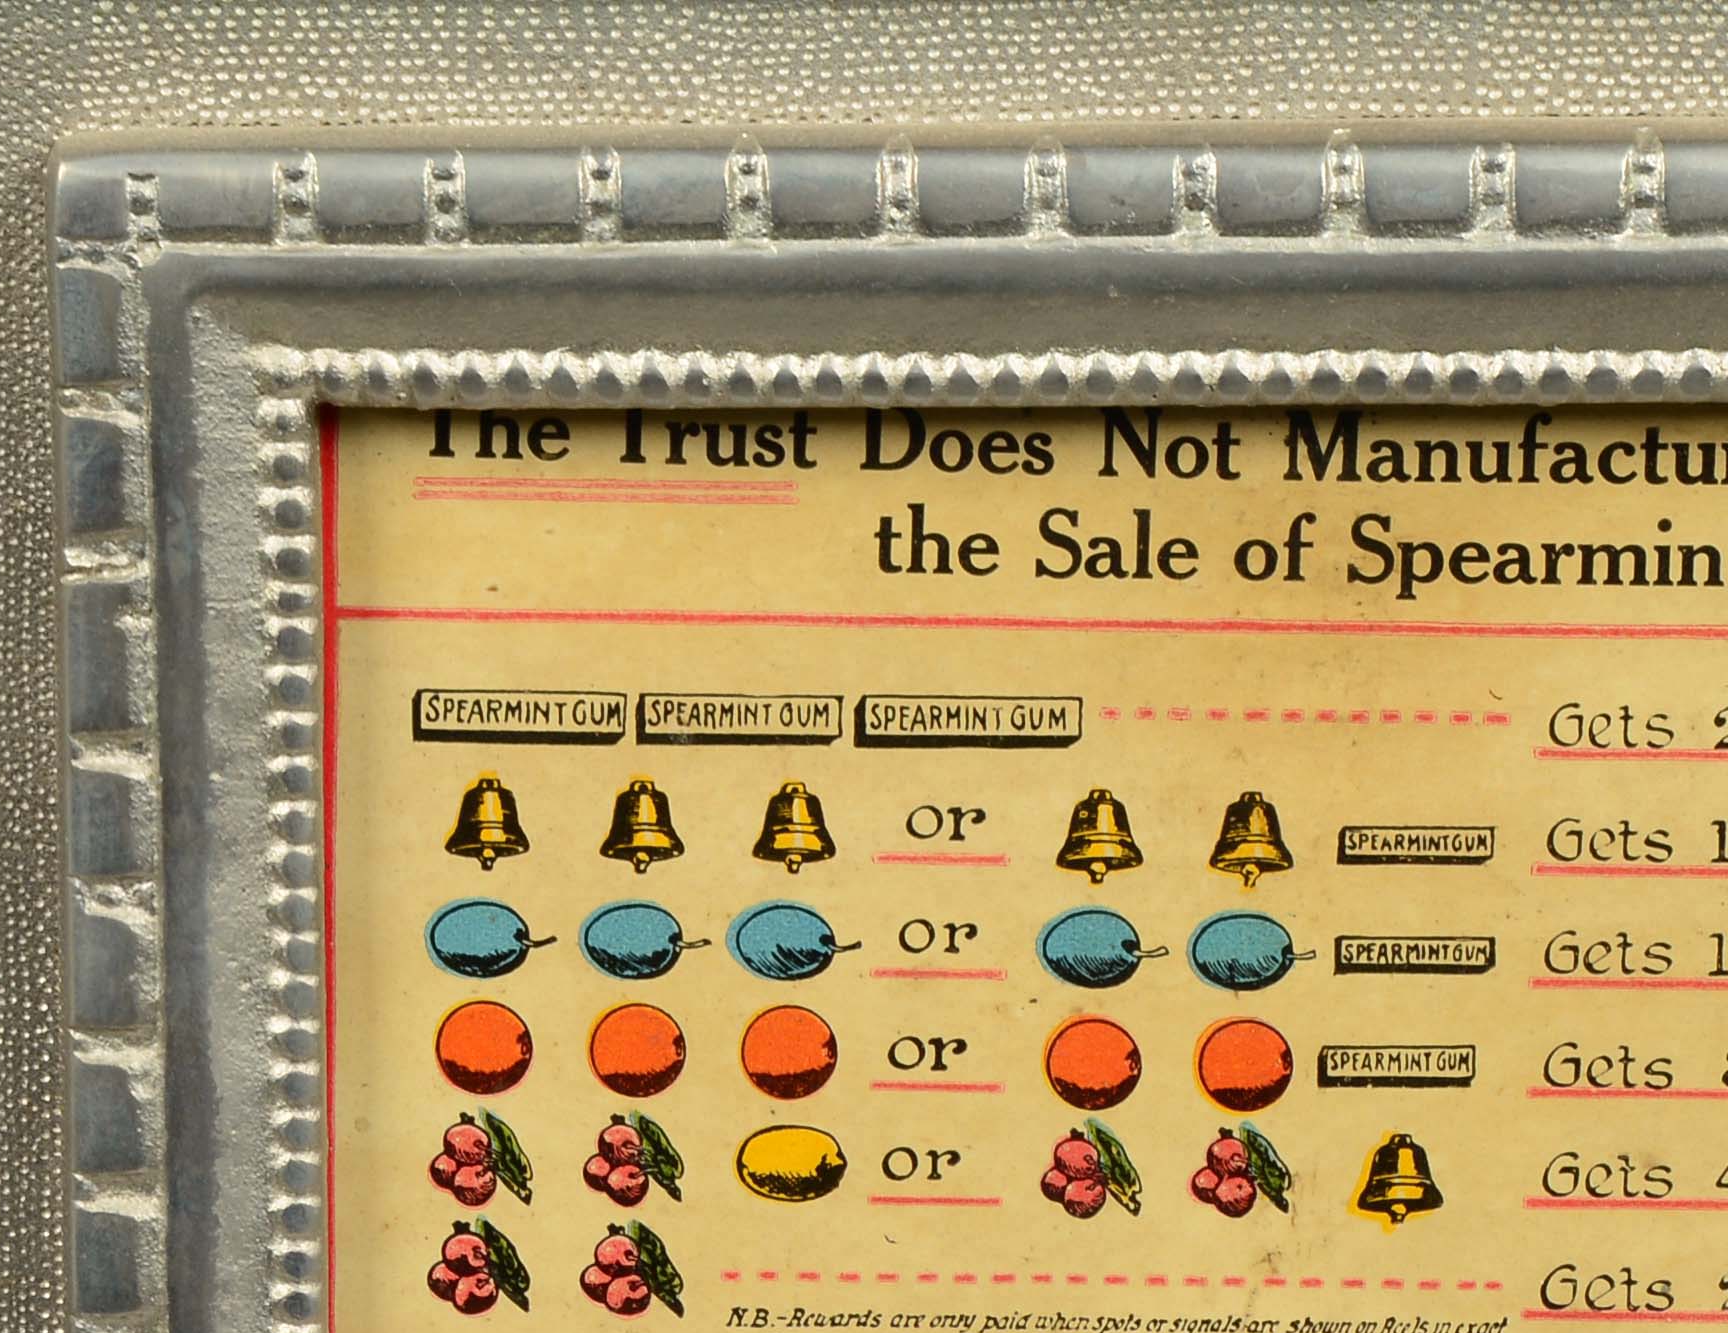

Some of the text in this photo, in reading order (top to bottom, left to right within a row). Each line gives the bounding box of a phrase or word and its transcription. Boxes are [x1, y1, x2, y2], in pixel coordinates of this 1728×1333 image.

[859, 407, 1056, 476] Does
[1097, 407, 1242, 480] Not
[874, 502, 1000, 577] the
[1035, 507, 1199, 580] Sale
[1233, 511, 1317, 582] of
[424, 693, 624, 726] SPEARMINT GUM
[646, 698, 772, 728] SPEARMINT
[868, 703, 1068, 733] SPEARMINT GUM
[1549, 702, 1674, 749] Gets
[905, 805, 986, 841] or
[1546, 817, 1673, 863] Gets
[1346, 831, 1489, 852] SPEARMINT GUM
[898, 918, 978, 954] or
[1342, 942, 1490, 964] SPEARMINT GUM
[1544, 930, 1673, 975] Gets
[887, 1036, 968, 1071] or
[1329, 1050, 1471, 1073] SPEARMINT GUM
[1543, 1042, 1673, 1090] Gets
[881, 1146, 961, 1181] or
[1542, 1151, 1673, 1199] Gets
[1540, 1263, 1674, 1312] Gets
[890, 1313, 924, 1329] are
[980, 1311, 1033, 1333] paid
[1035, 1312, 1090, 1331] when
[1146, 1318, 1168, 1333] or
[1247, 1320, 1280, 1333] are
